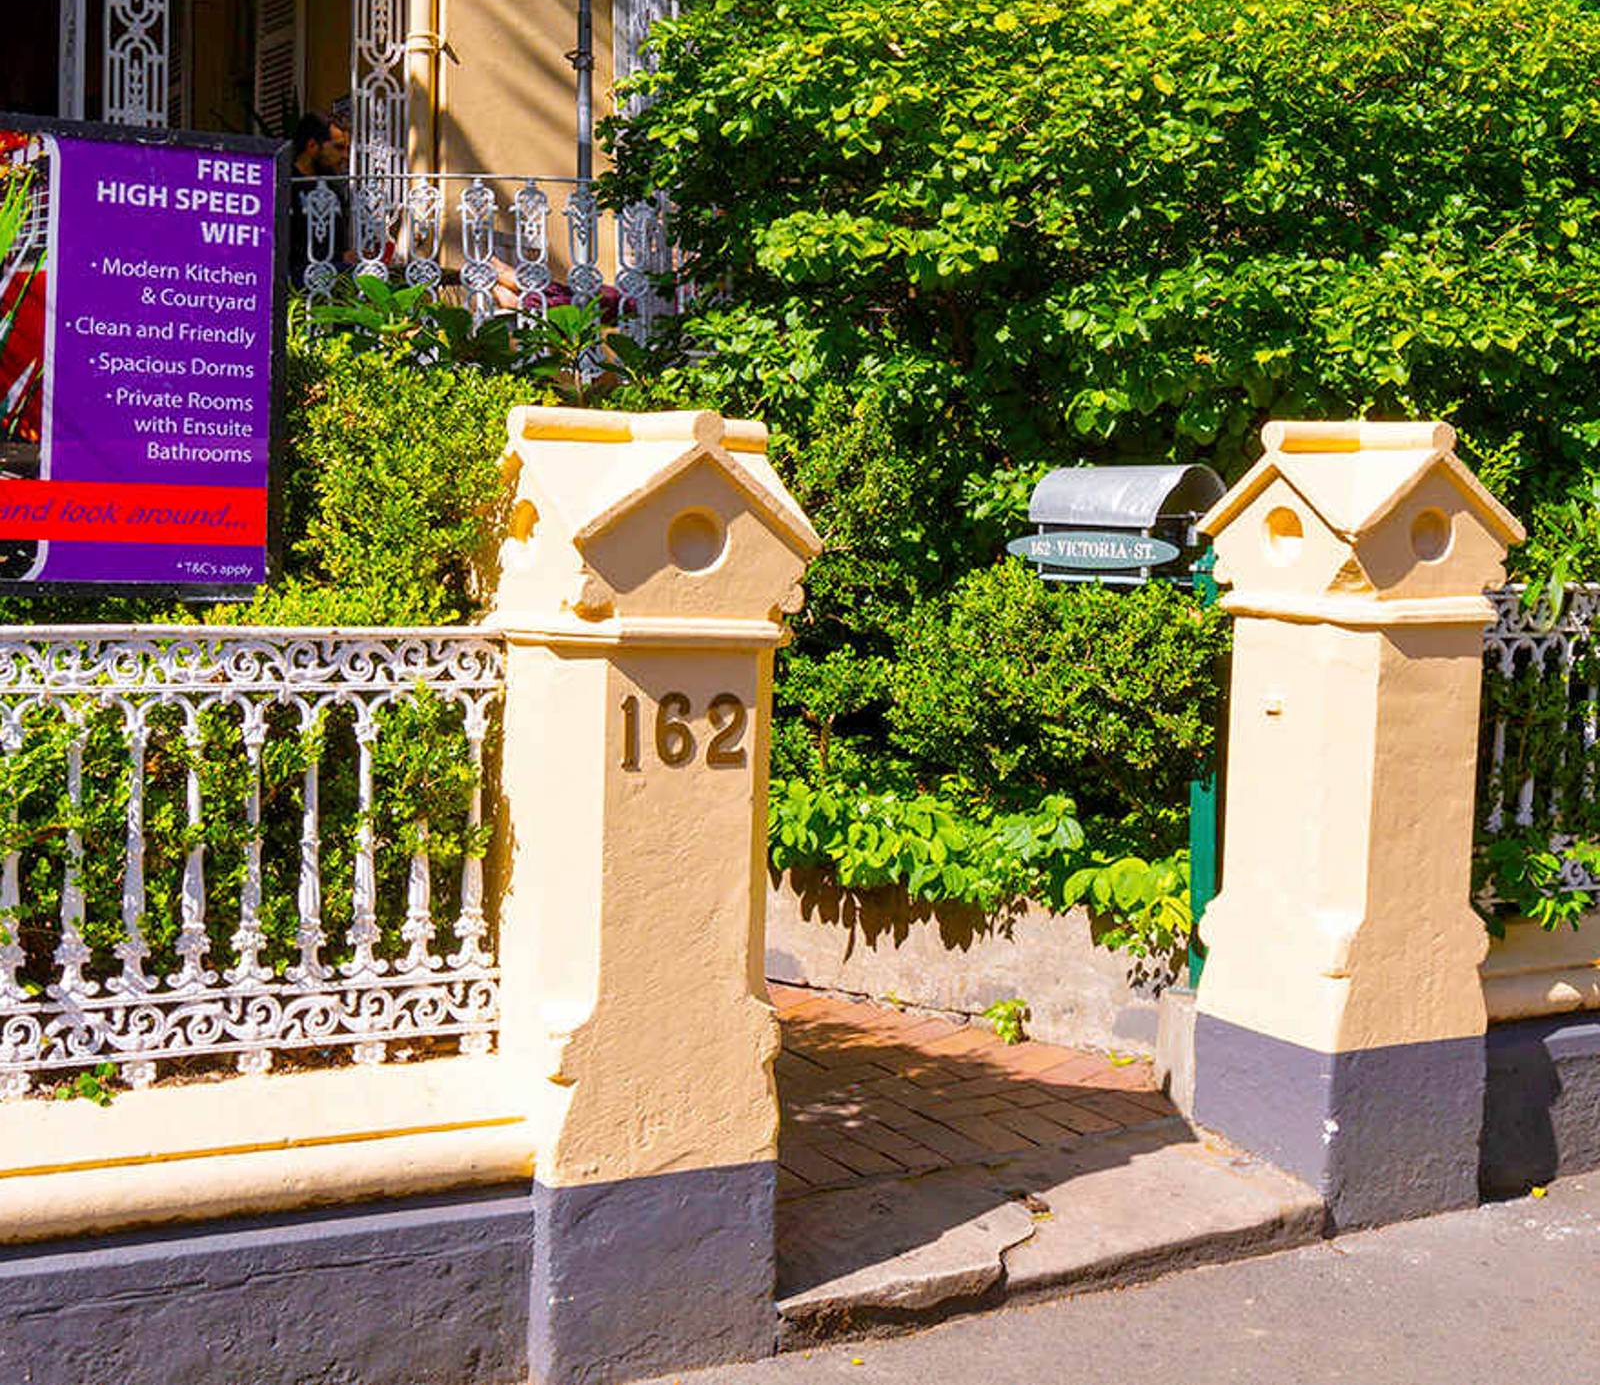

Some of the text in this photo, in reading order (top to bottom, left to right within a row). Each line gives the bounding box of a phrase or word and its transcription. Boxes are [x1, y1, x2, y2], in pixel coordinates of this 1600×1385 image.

[197, 158, 263, 186] FREE
[96, 181, 261, 215] HIGH SPEED
[102, 257, 257, 286] Modern Kitchen
[141, 286, 257, 312] & Courtyard
[75, 317, 256, 348] Clean and Friendly
[98, 353, 254, 378] Spacious Dorms
[117, 388, 254, 412] Private Rooms
[134, 415, 254, 438] with Ensuite
[147, 442, 253, 464] Bathrooms
[59, 500, 121, 524] look
[1056, 541, 1127, 559] VICTORIA
[1134, 543, 1156, 560] ST.
[219, 564, 254, 579] apply
[620, 692, 749, 772] 162
